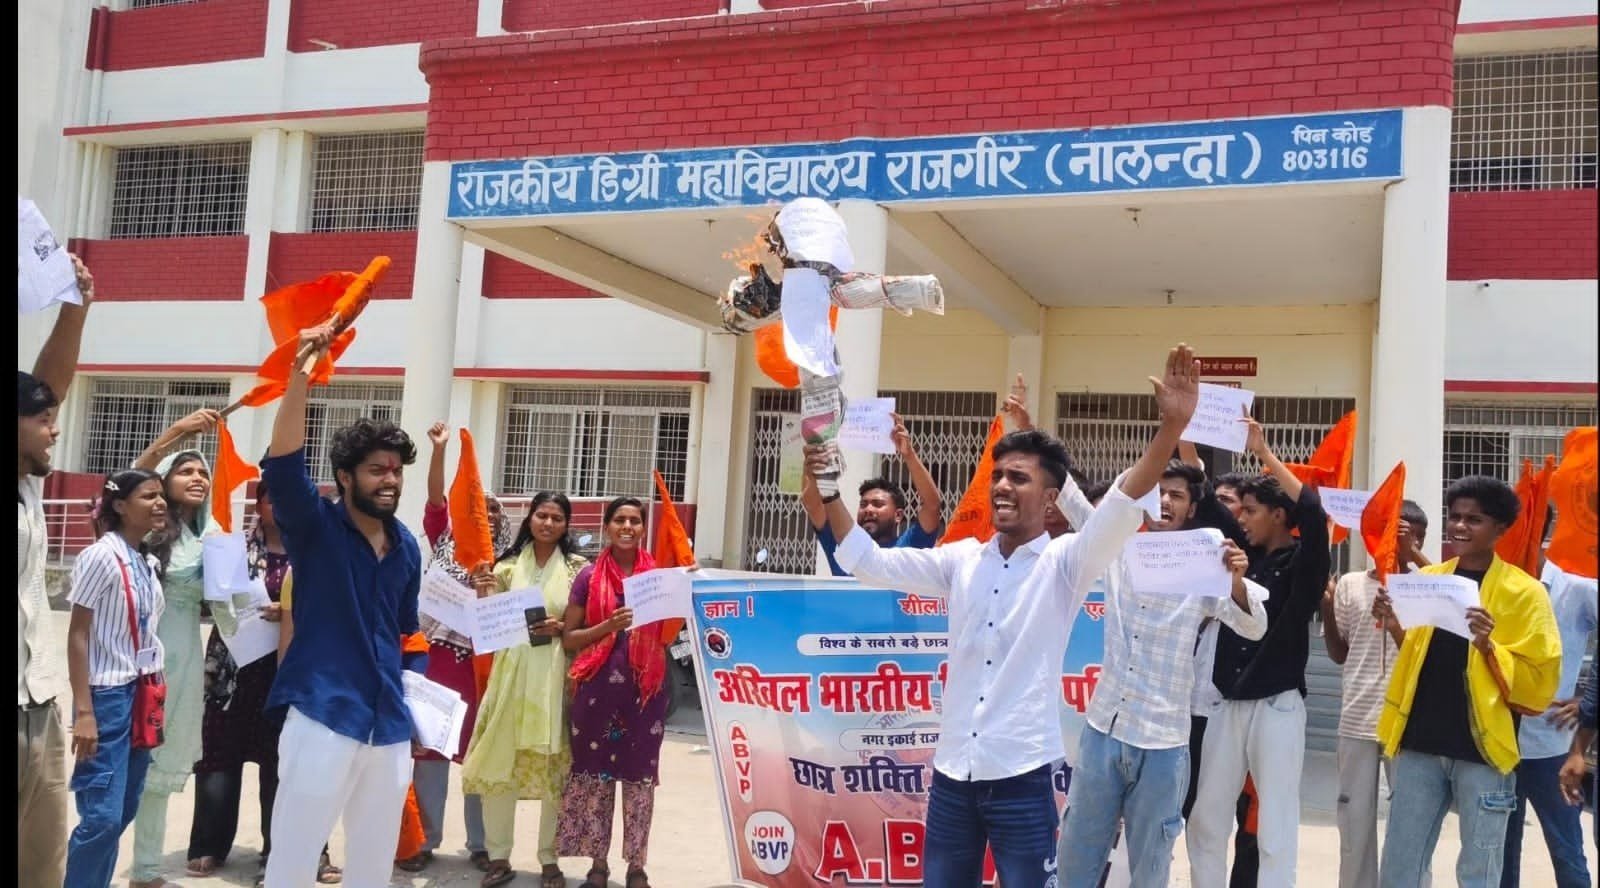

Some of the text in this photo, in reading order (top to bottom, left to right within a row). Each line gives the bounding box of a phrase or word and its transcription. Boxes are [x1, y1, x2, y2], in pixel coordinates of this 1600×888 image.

[1292, 121, 1372, 146] पिन कोड
[1283, 147, 1368, 172] 803116
[457, 159, 585, 209] राजकीय
[590, 156, 667, 202] डिग्री
[674, 149, 875, 198] महाविद्यालय
[885, 136, 1037, 195] राजगीर
[819, 636, 846, 648] विश्व
[849, 636, 862, 648] के
[864, 636, 896, 648] सबसे
[713, 664, 812, 713] अखिल
[819, 662, 934, 713] भारतीय
[862, 731, 940, 747] नगर इकाई राज
[788, 756, 925, 794] छात्र शक्ति
[752, 826, 785, 839] JOIN
[815, 820, 925, 884] A.B
